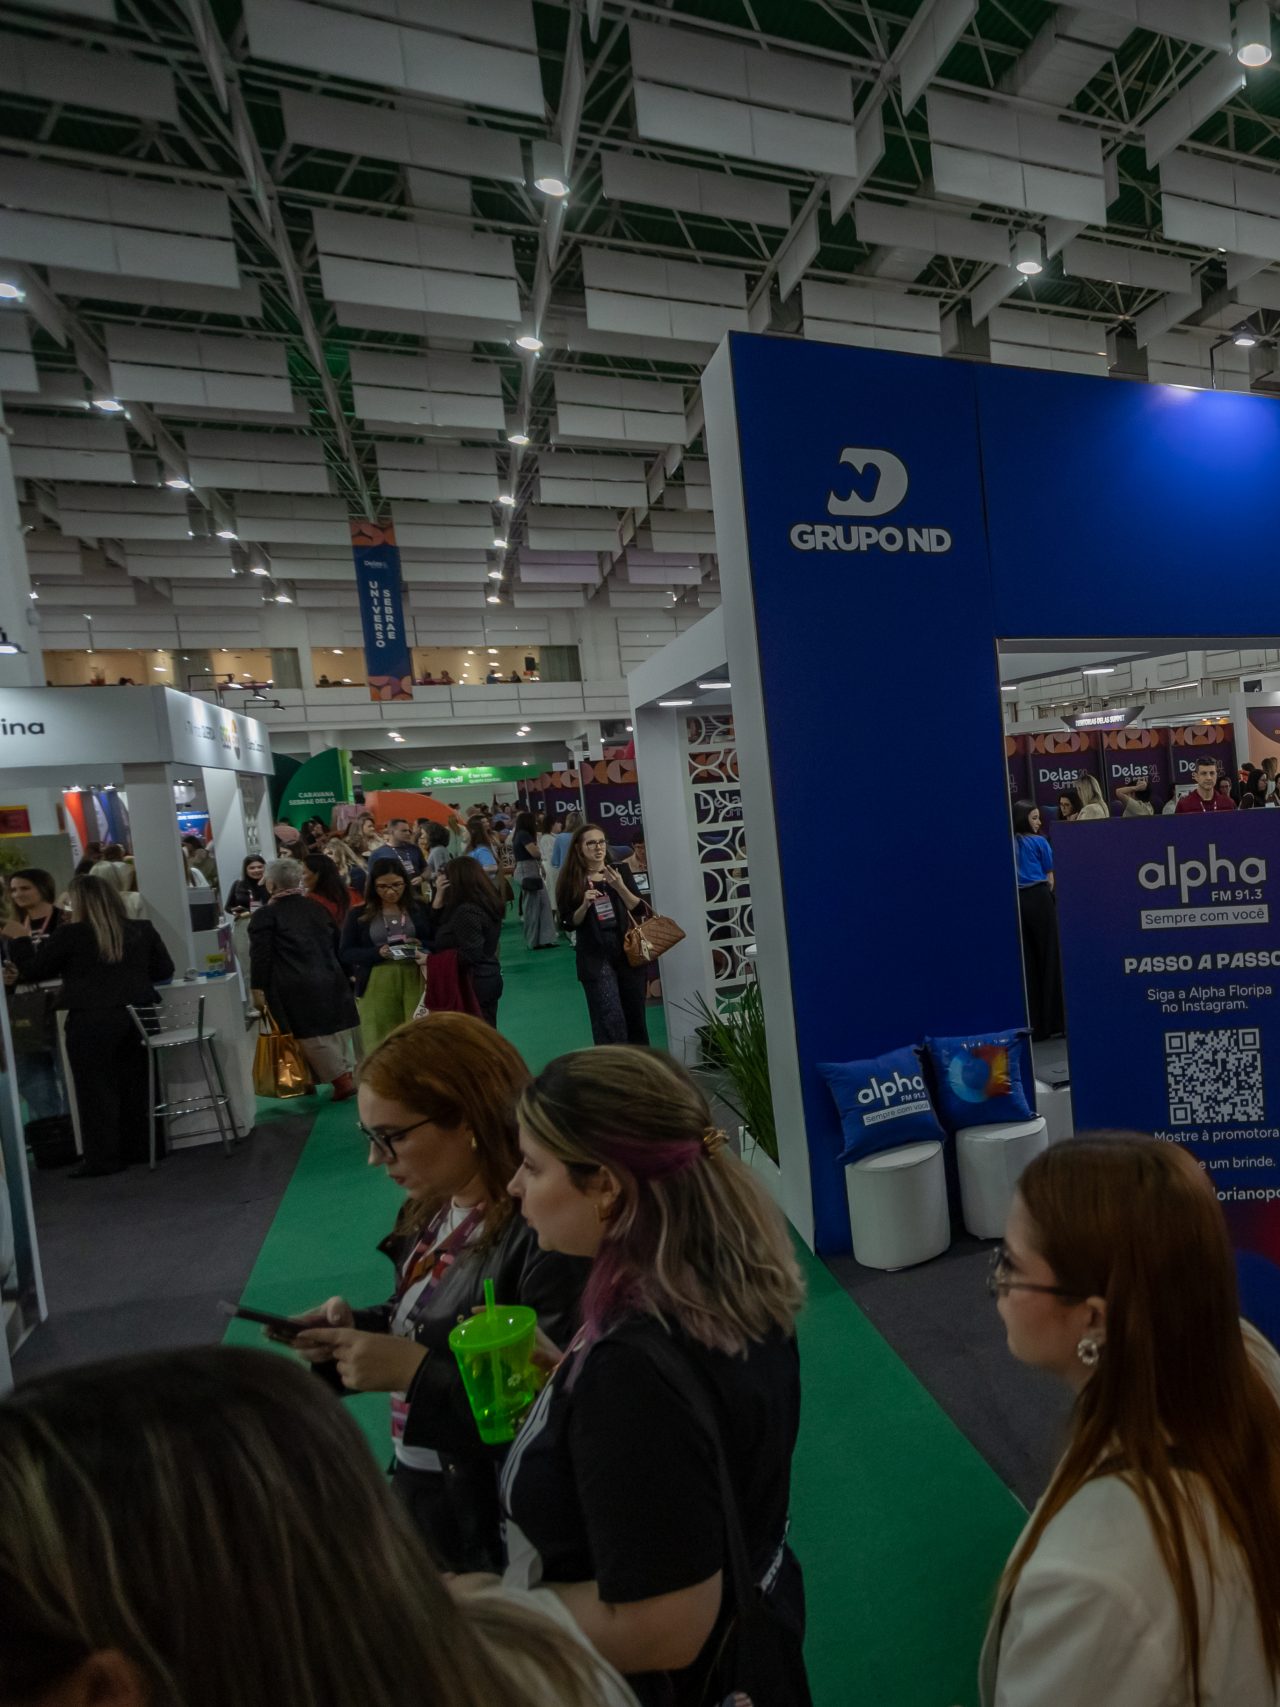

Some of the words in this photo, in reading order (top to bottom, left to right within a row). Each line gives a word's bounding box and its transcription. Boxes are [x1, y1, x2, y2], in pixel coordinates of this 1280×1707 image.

[789, 523, 904, 552] GRUPO
[906, 527, 952, 553] ND
[368, 580, 386, 648] UNIVERSO
[382, 588, 397, 640] SEBRAE
[1039, 767, 1079, 783] Delas
[1111, 763, 1148, 778] Delas
[433, 775, 464, 785] Sicredi
[1138, 843, 1267, 904] alpha
[1211, 890, 1232, 902] FM
[1235, 888, 1263, 901] 91.3
[1145, 912, 1196, 926] Sempre
[1200, 910, 1229, 922] com
[1232, 907, 1265, 920] você
[1124, 955, 1194, 974] PASSO
[1197, 953, 1212, 970] A
[1147, 987, 1175, 1003] Siga
[1178, 991, 1186, 999] a
[1189, 985, 1226, 1000] Alpha
[1229, 983, 1272, 998] Floripa
[1162, 1003, 1178, 1013] no
[1182, 998, 1249, 1014] Instagram.
[857, 1071, 925, 1107] alpha
[900, 1093, 912, 1102] FM
[865, 1108, 896, 1123] Sempre
[1154, 1130, 1199, 1143] Mostre
[1201, 1129, 1209, 1141] à
[1209, 1158, 1230, 1170] um
[1232, 1156, 1277, 1168] brinde.
